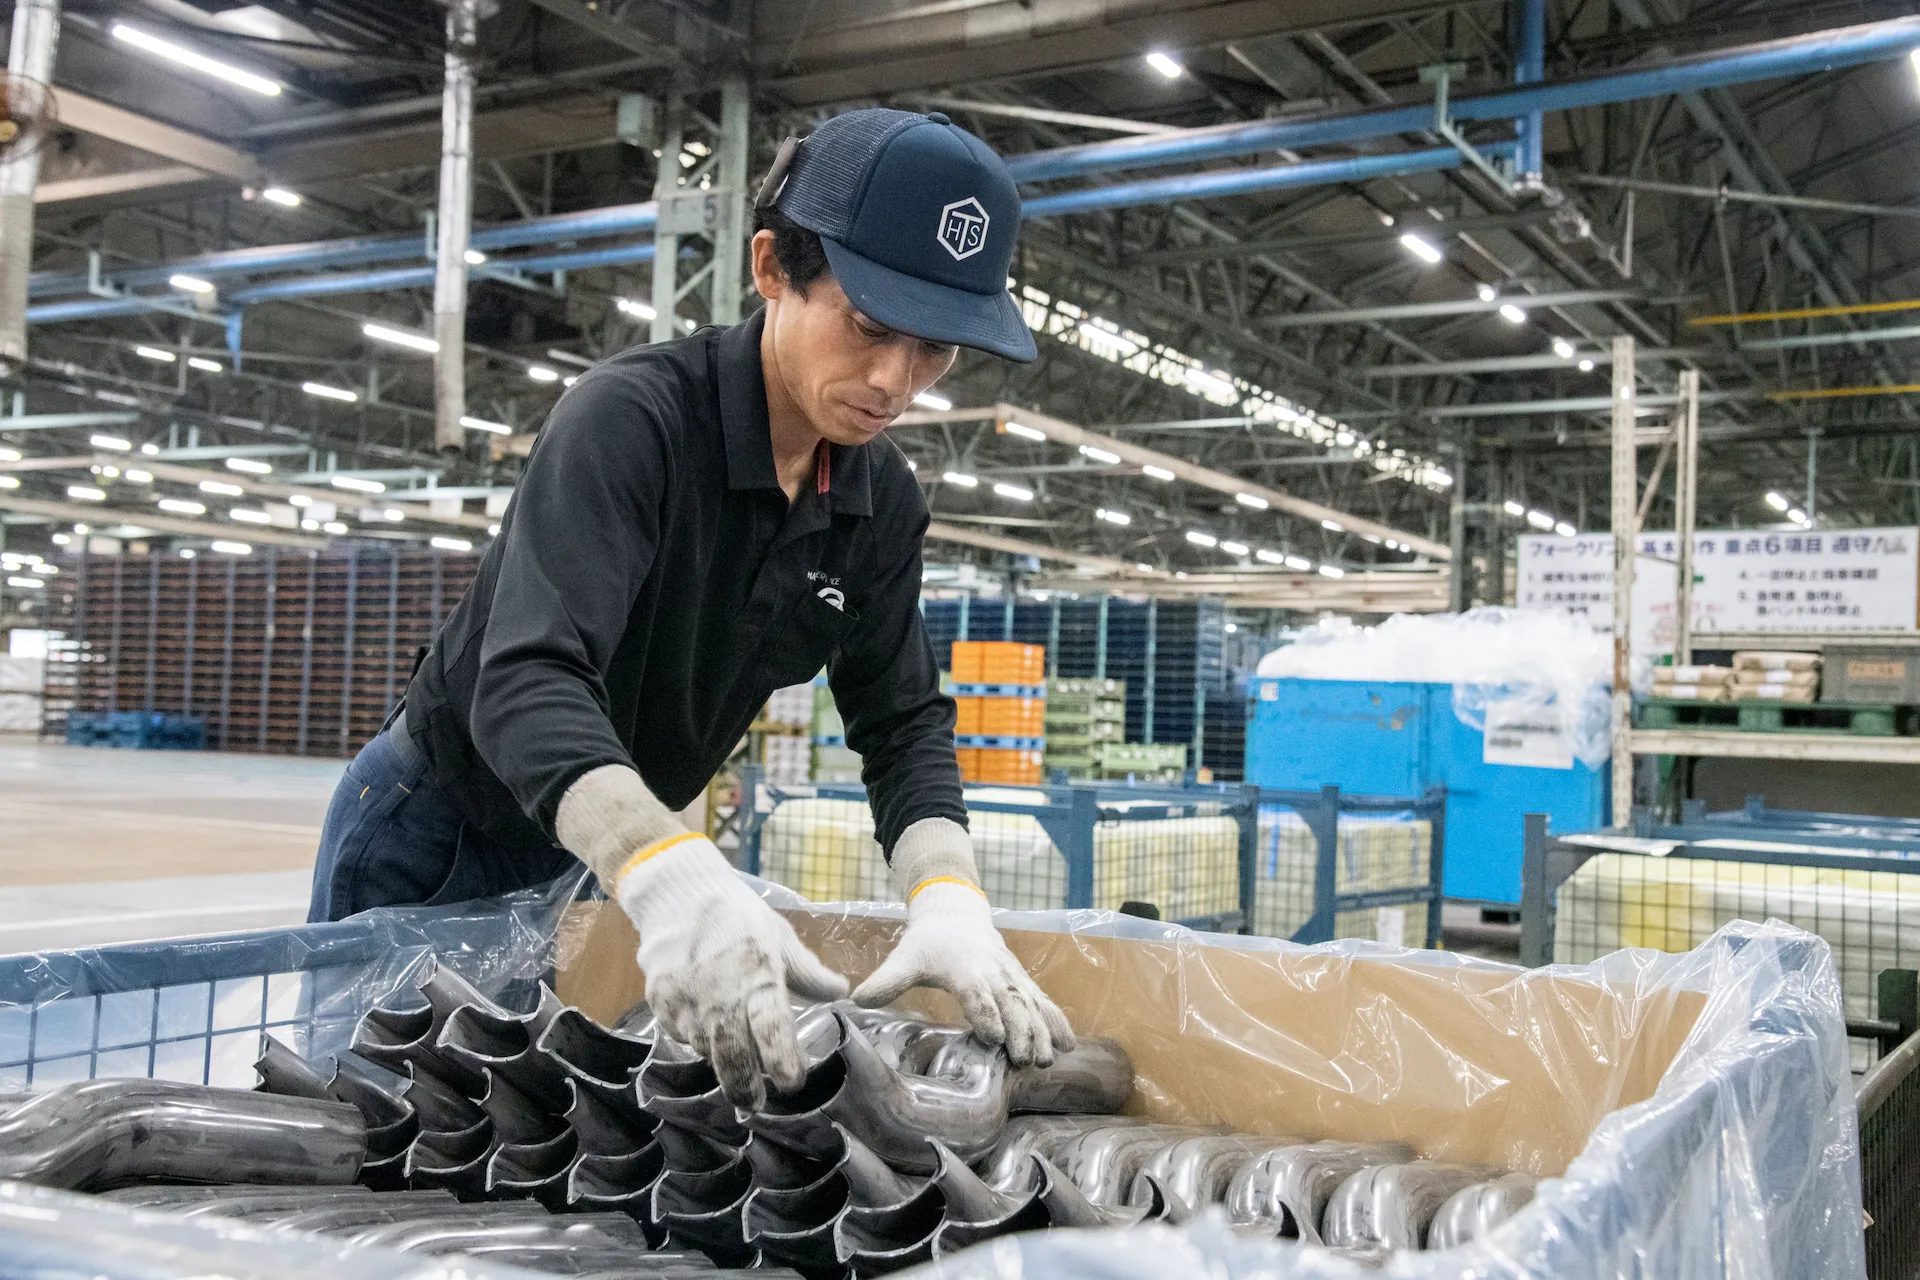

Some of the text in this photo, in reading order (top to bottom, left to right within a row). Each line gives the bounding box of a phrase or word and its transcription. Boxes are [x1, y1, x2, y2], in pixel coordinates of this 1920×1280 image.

[1529, 540, 1614, 557] フォークリ
[1643, 540, 1716, 555] 基本作
